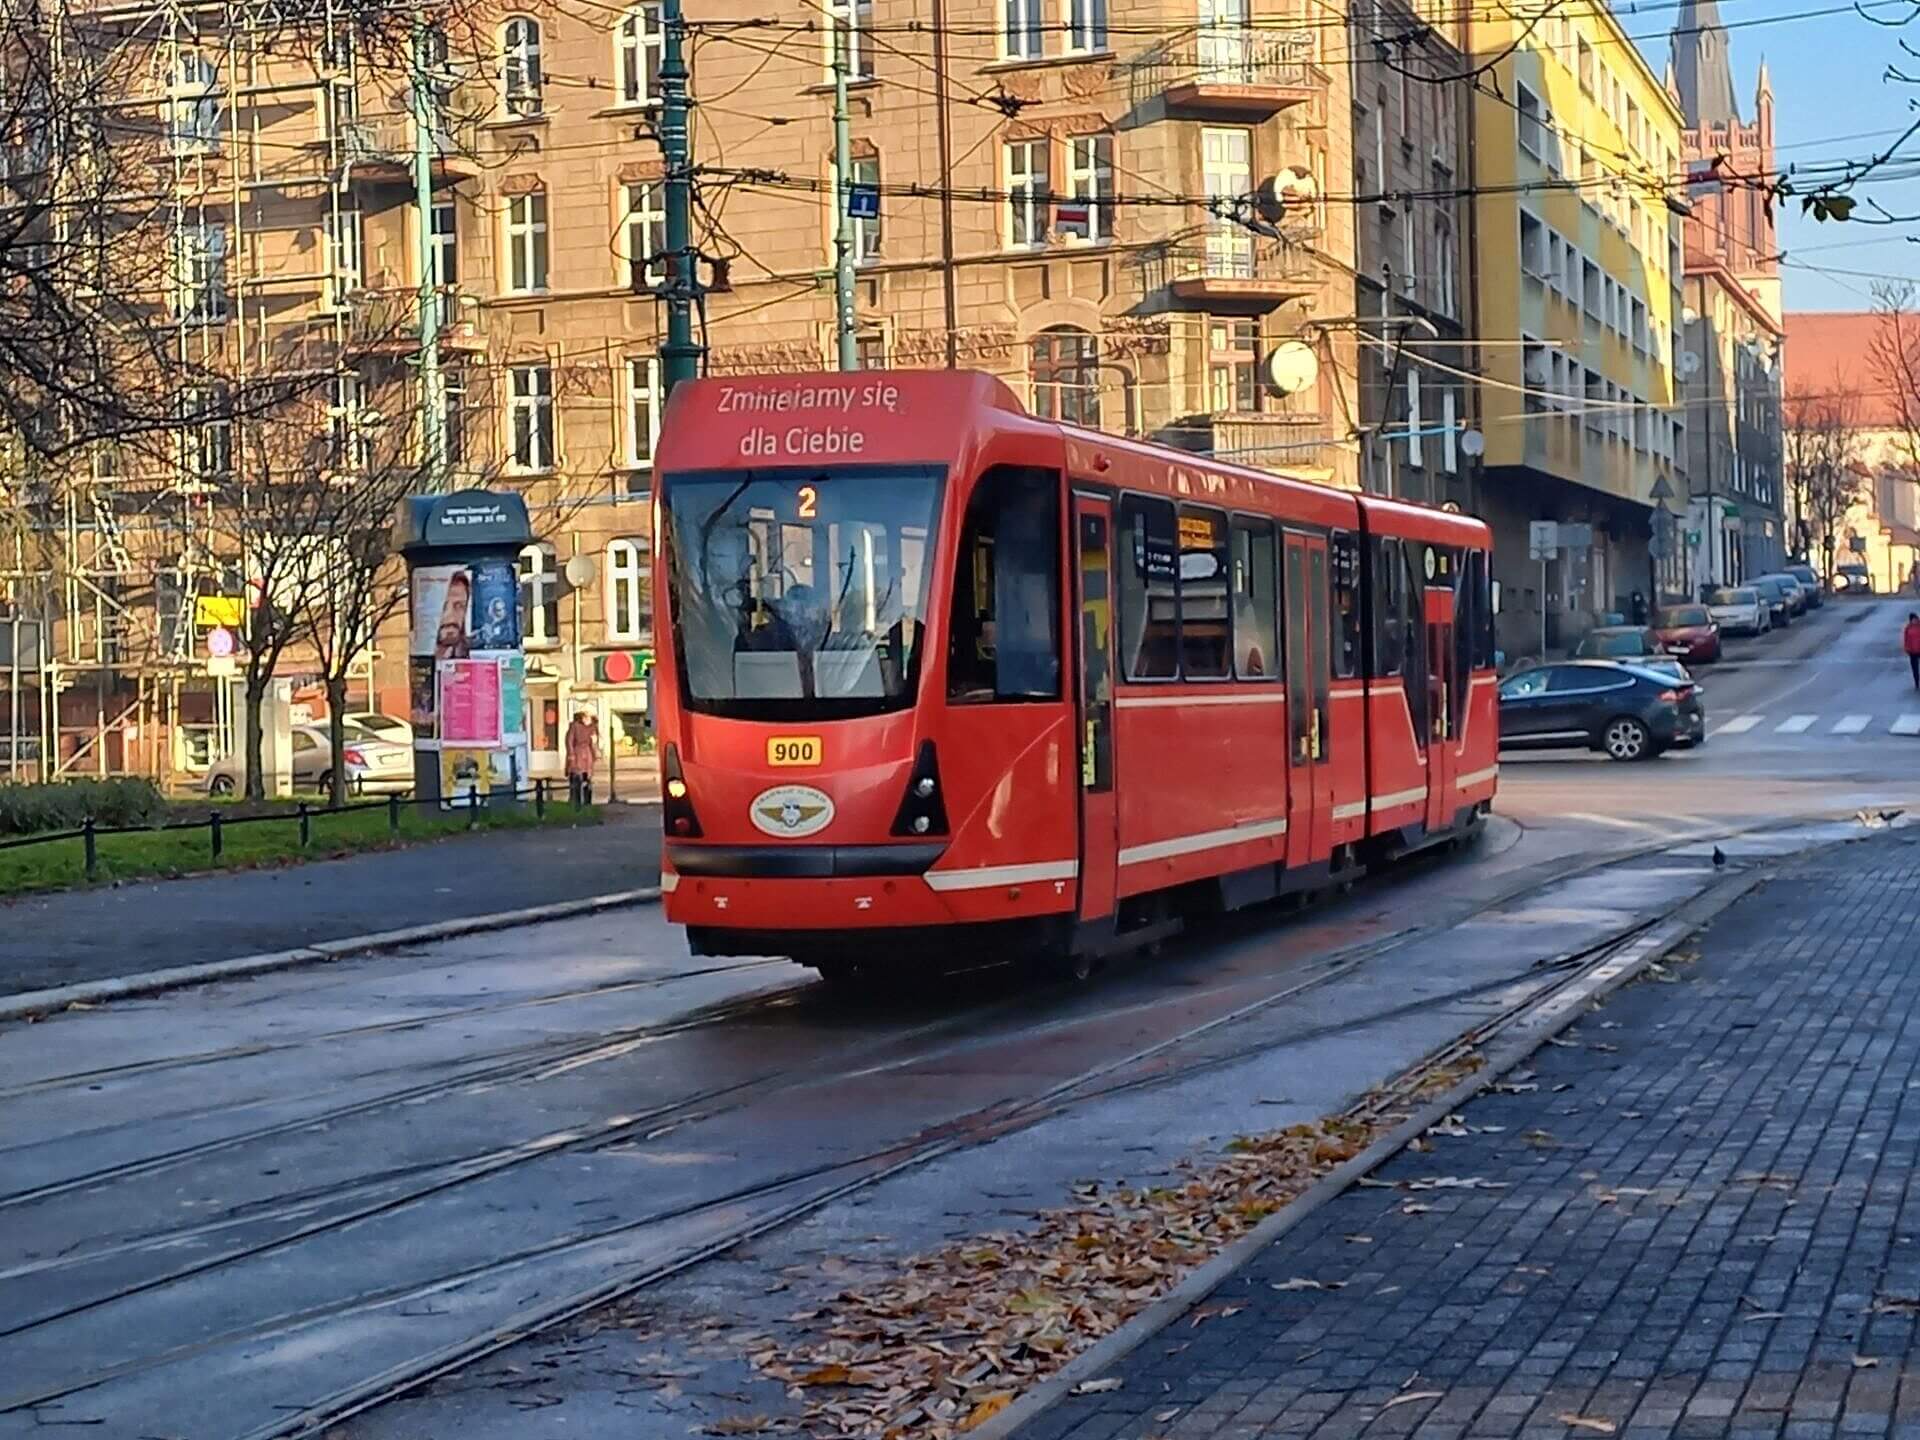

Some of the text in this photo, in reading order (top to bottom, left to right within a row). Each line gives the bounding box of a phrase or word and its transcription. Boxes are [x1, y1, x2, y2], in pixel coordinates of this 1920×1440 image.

[861, 380, 898, 412] się
[740, 425, 864, 456] dla Ciebie
[798, 487, 816, 517] 2
[775, 743, 813, 761] 900
